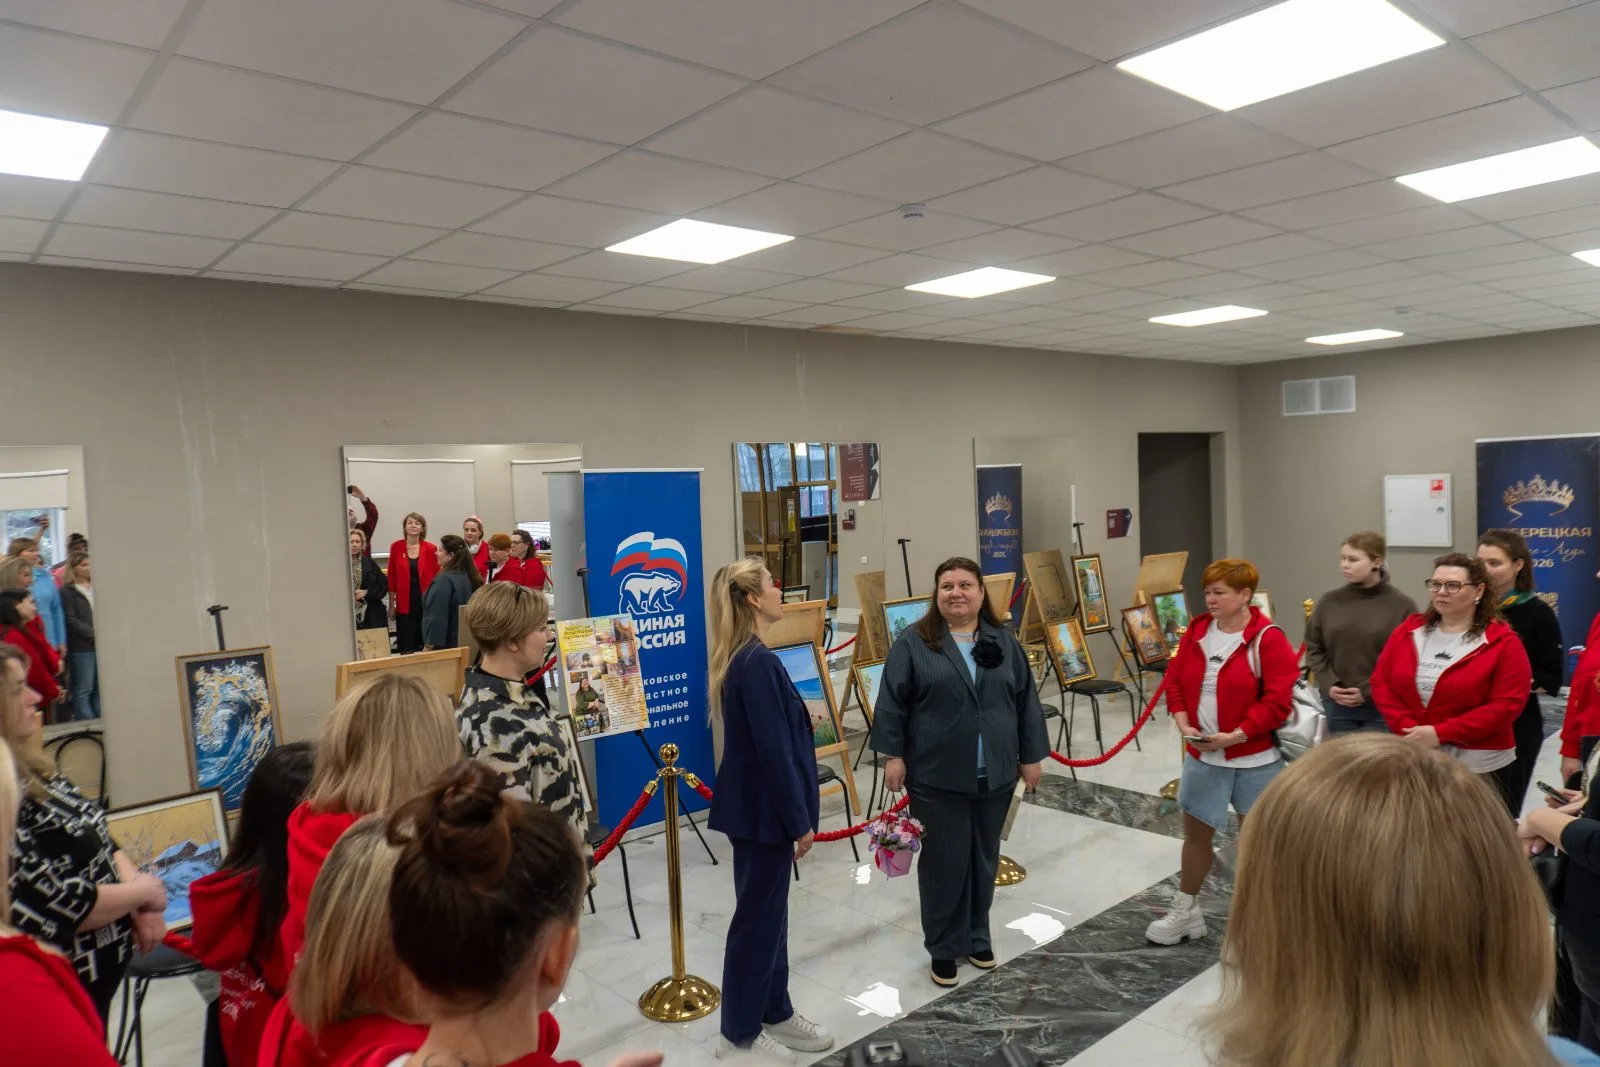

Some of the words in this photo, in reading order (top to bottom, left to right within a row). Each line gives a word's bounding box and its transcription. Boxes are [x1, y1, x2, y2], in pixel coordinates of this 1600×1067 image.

[1512, 527, 1592, 538] ЕРЕЦКАЯ
[1532, 558, 1554, 568] 026
[633, 614, 685, 635] ИНАЯ
[635, 630, 686, 650] ССИЯ
[643, 672, 688, 686] ковское
[645, 686, 688, 700] астное
[647, 700, 689, 714] нальное
[648, 714, 690, 728] ление
